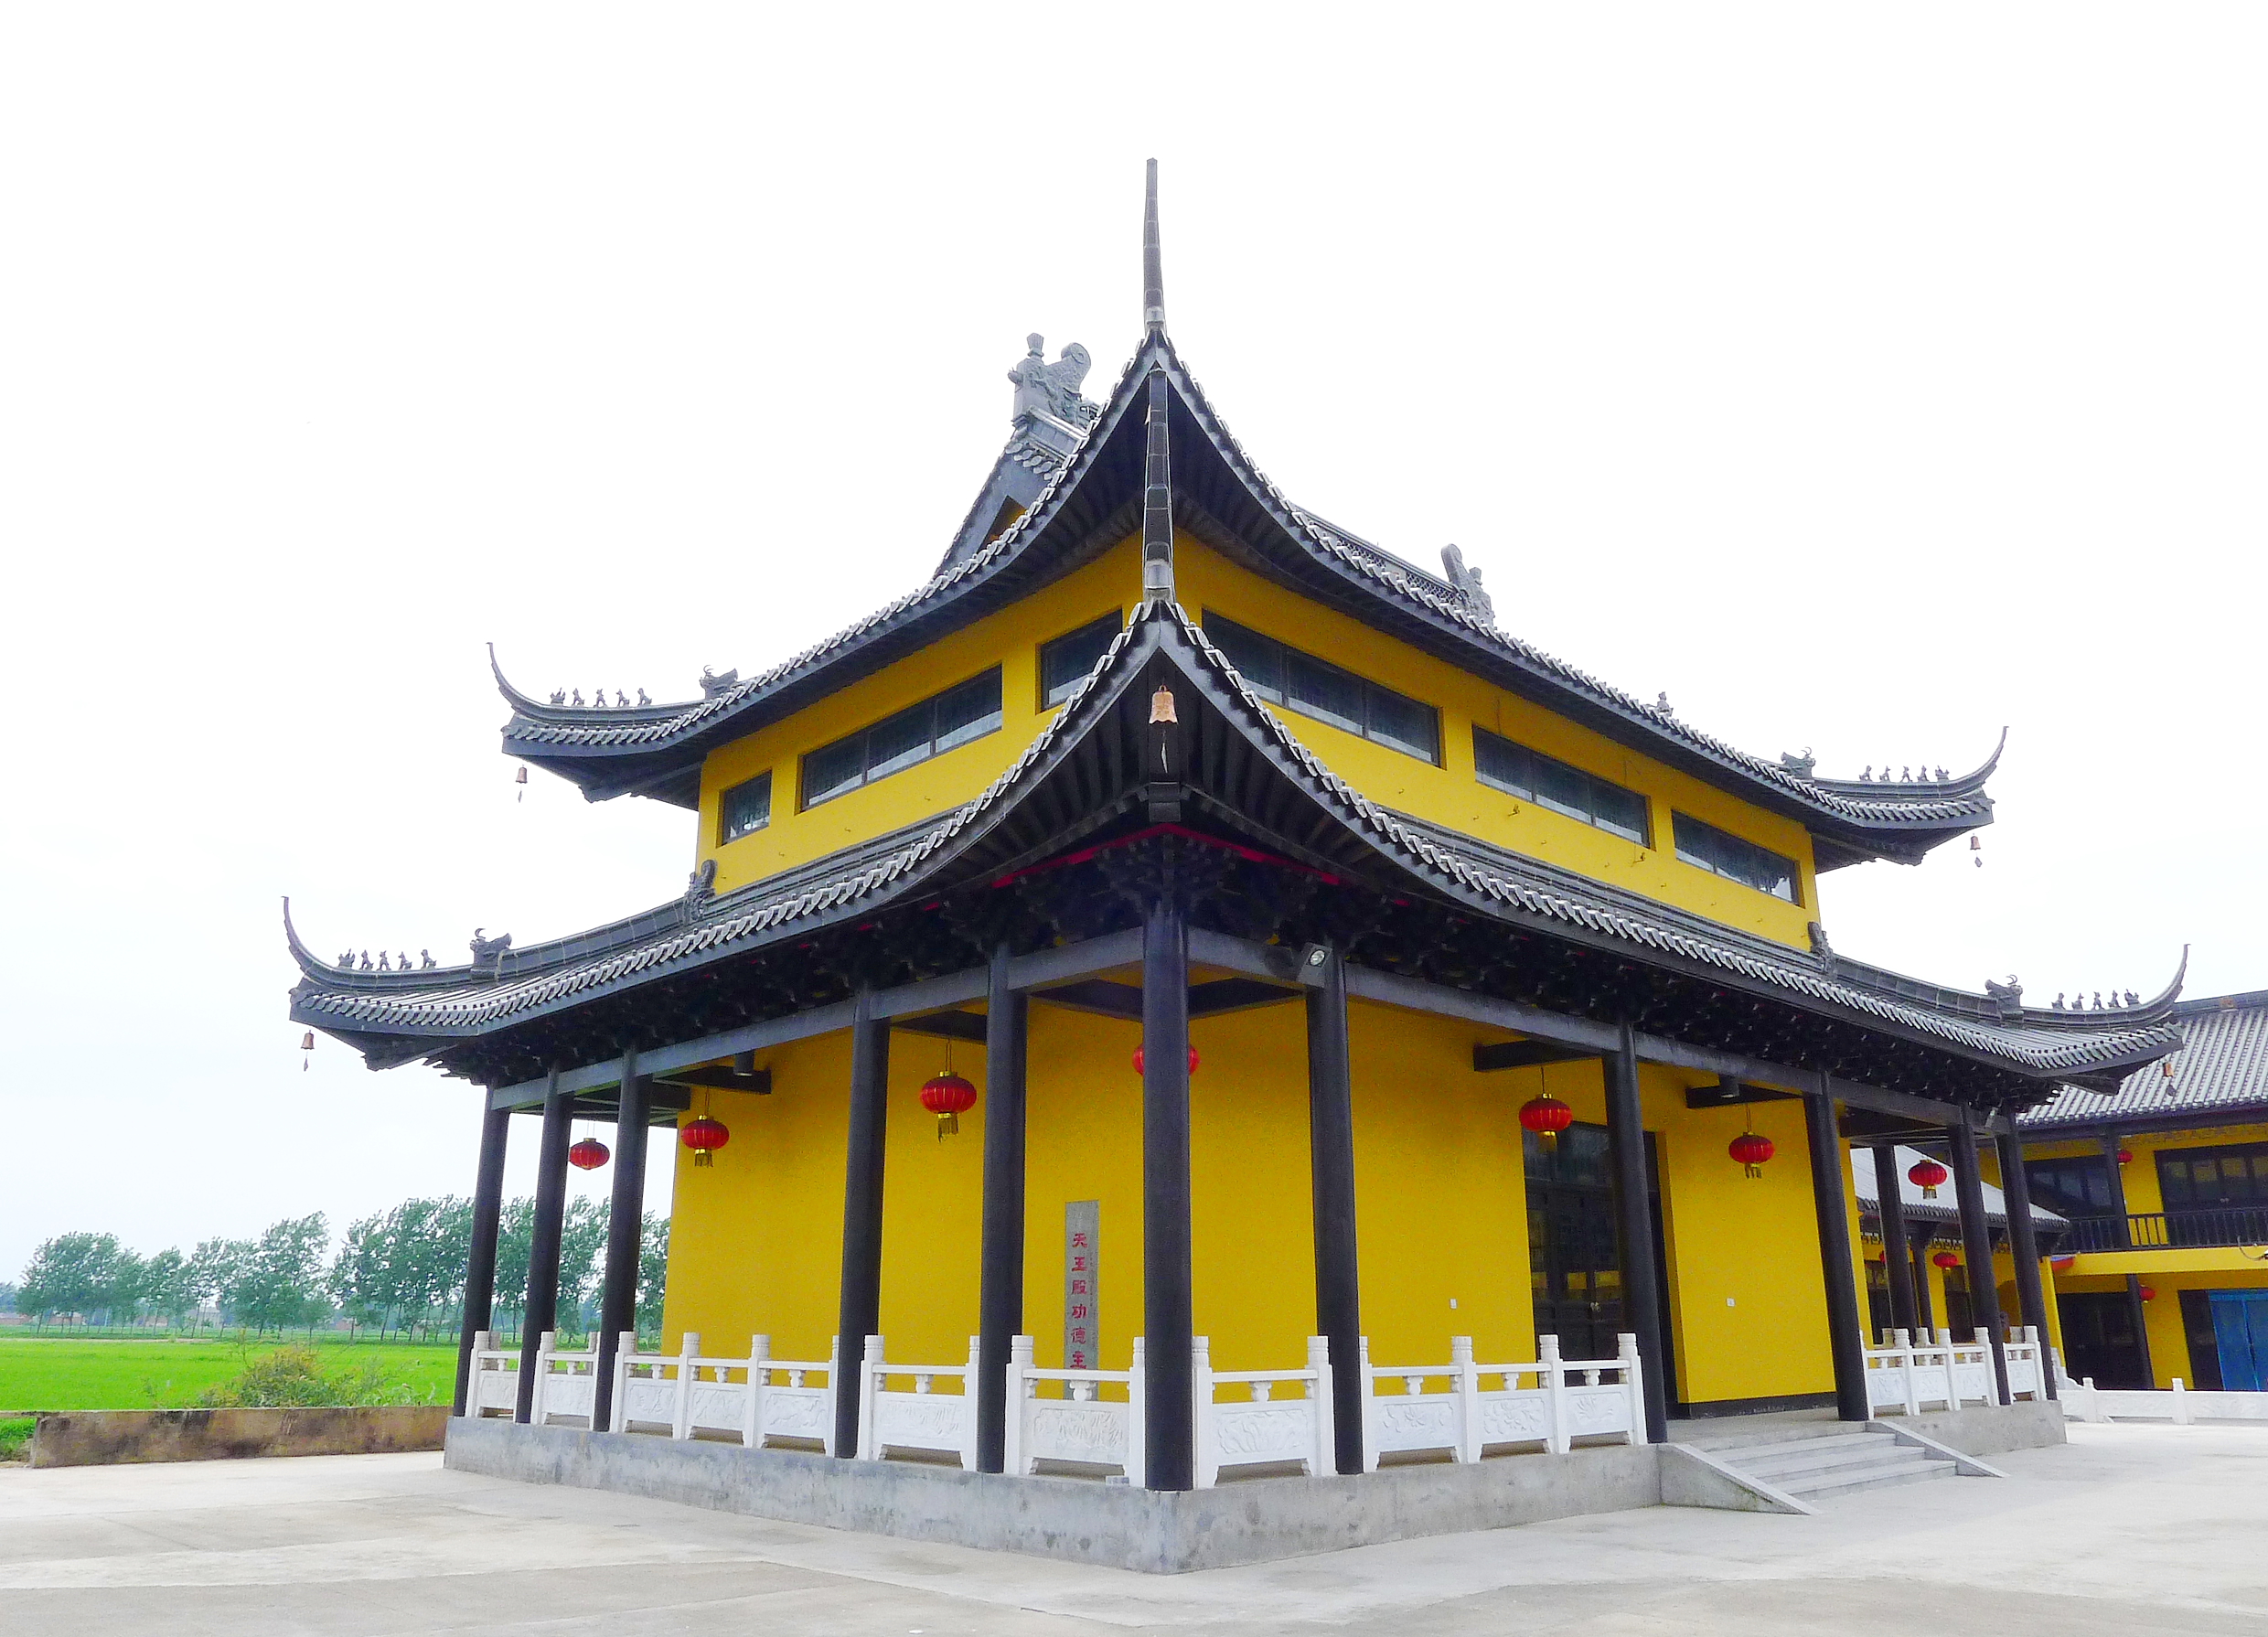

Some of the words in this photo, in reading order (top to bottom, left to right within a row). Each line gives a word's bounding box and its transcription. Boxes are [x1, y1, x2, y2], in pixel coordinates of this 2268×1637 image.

[1070, 1233, 1087, 1369] 天王殿功德主
